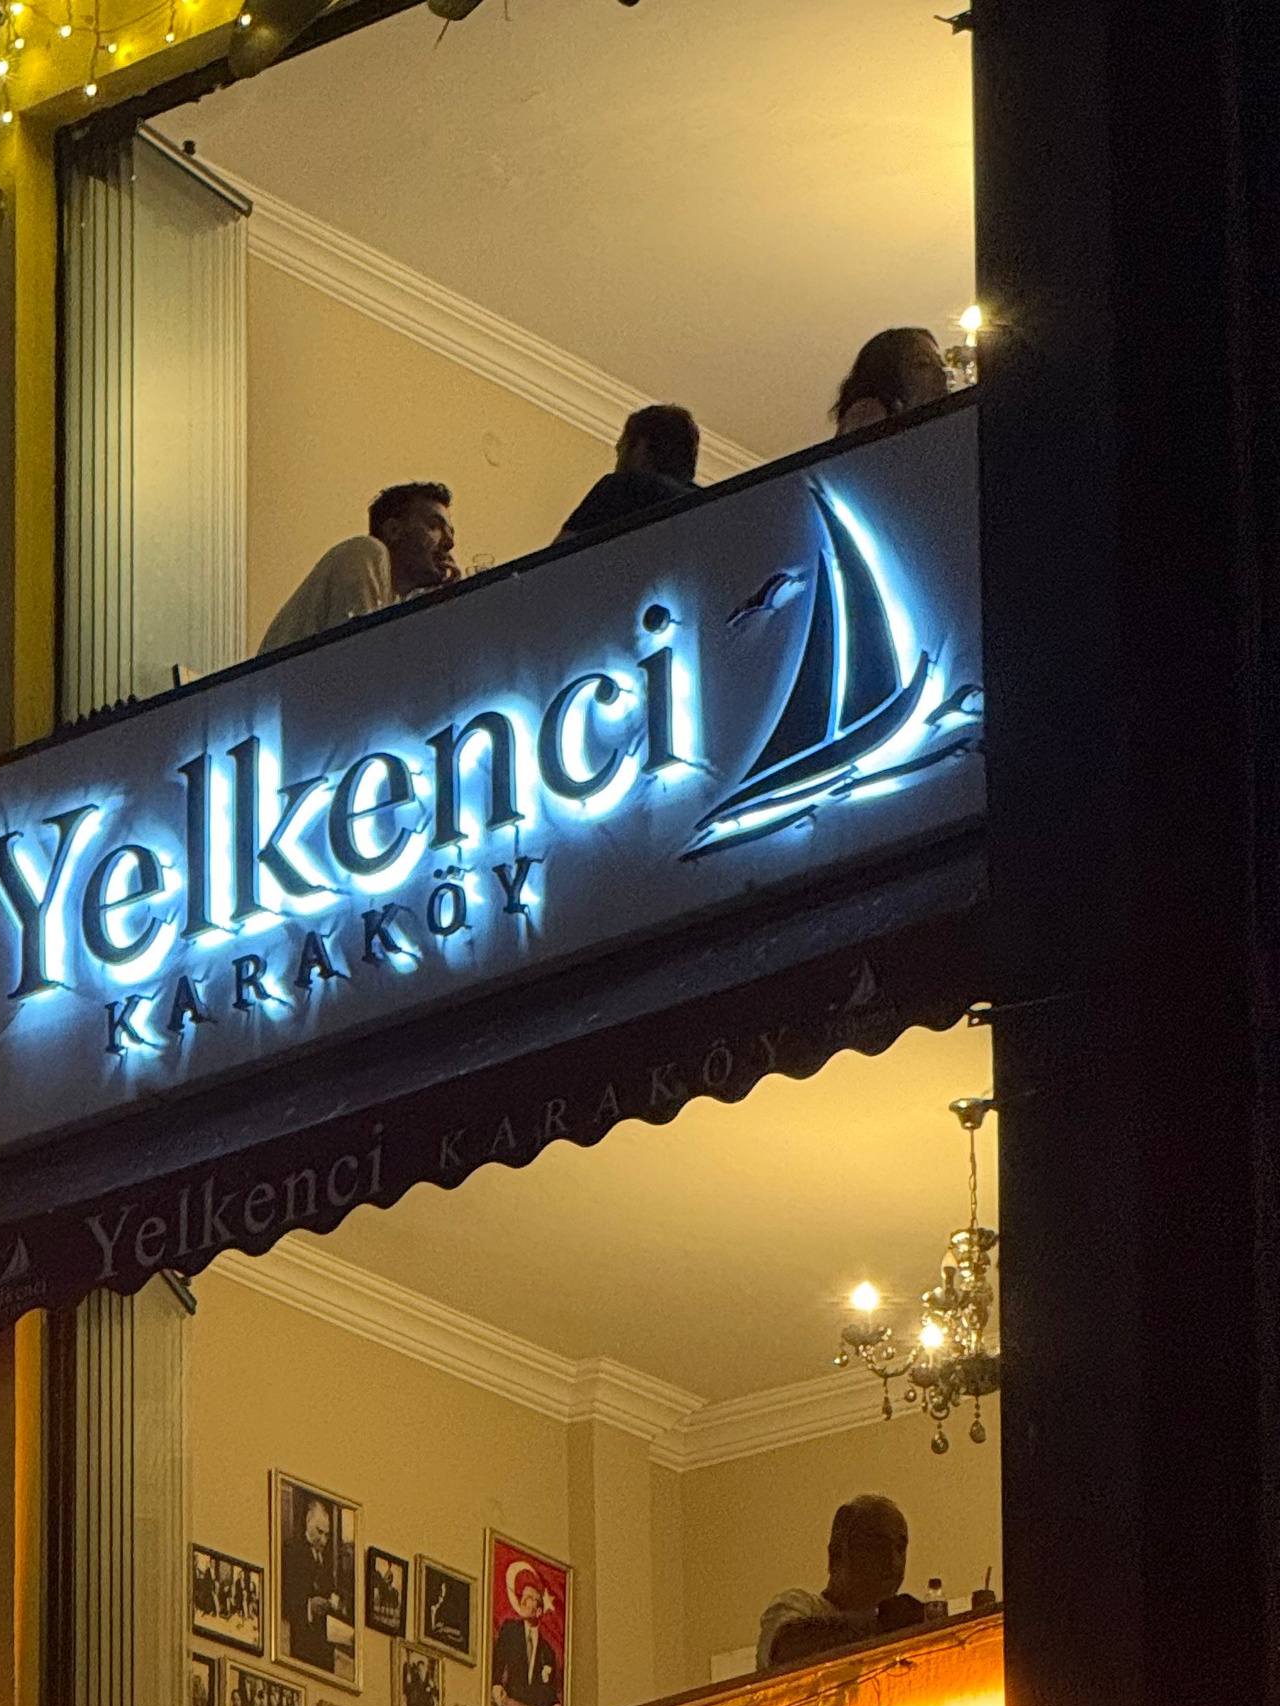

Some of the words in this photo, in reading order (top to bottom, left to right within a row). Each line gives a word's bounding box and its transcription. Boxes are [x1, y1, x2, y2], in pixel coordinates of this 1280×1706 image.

[106, 856, 542, 1055] KARAKÖY
[85, 1125, 386, 1280] Yelkenci
[438, 1028, 786, 1171] KARAKÖY
